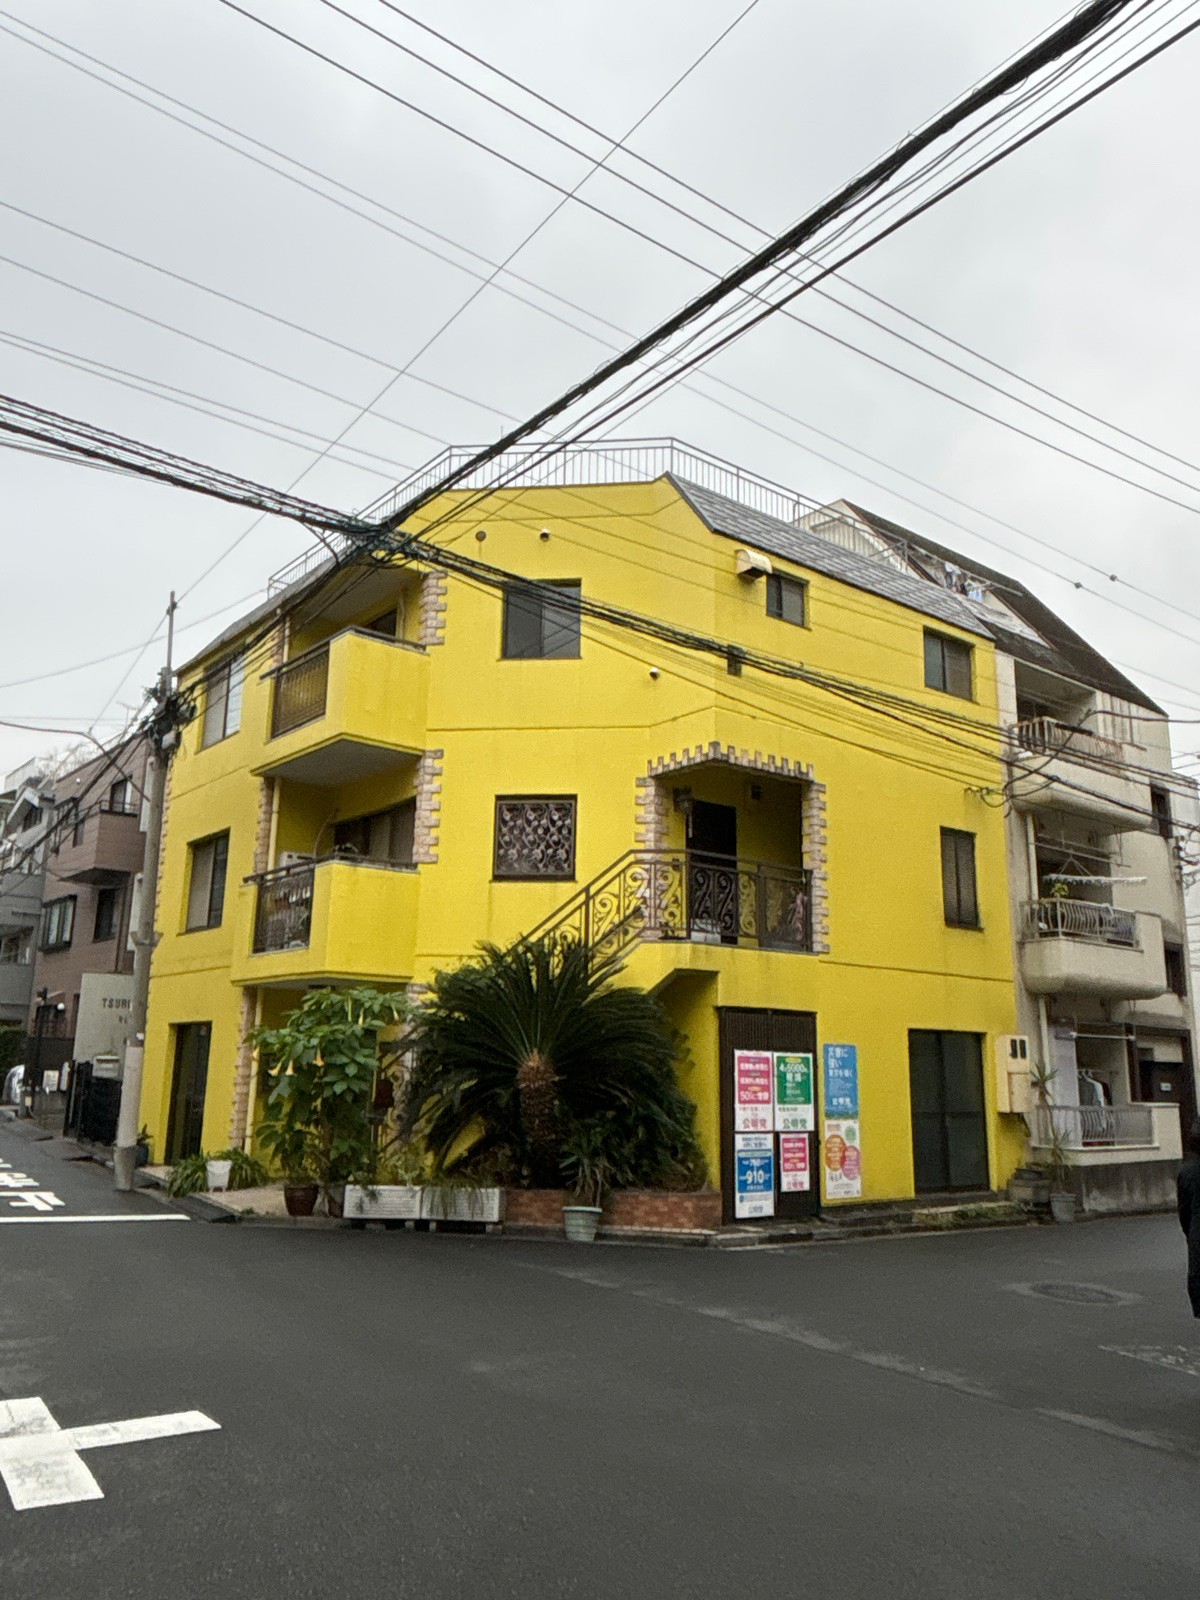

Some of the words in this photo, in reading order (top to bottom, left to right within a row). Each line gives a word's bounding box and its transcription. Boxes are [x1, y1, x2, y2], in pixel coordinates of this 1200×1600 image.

[743, 1118, 767, 1130] 公明党
[783, 1118, 808, 1130] 公明党
[745, 1169, 765, 1185] 910
